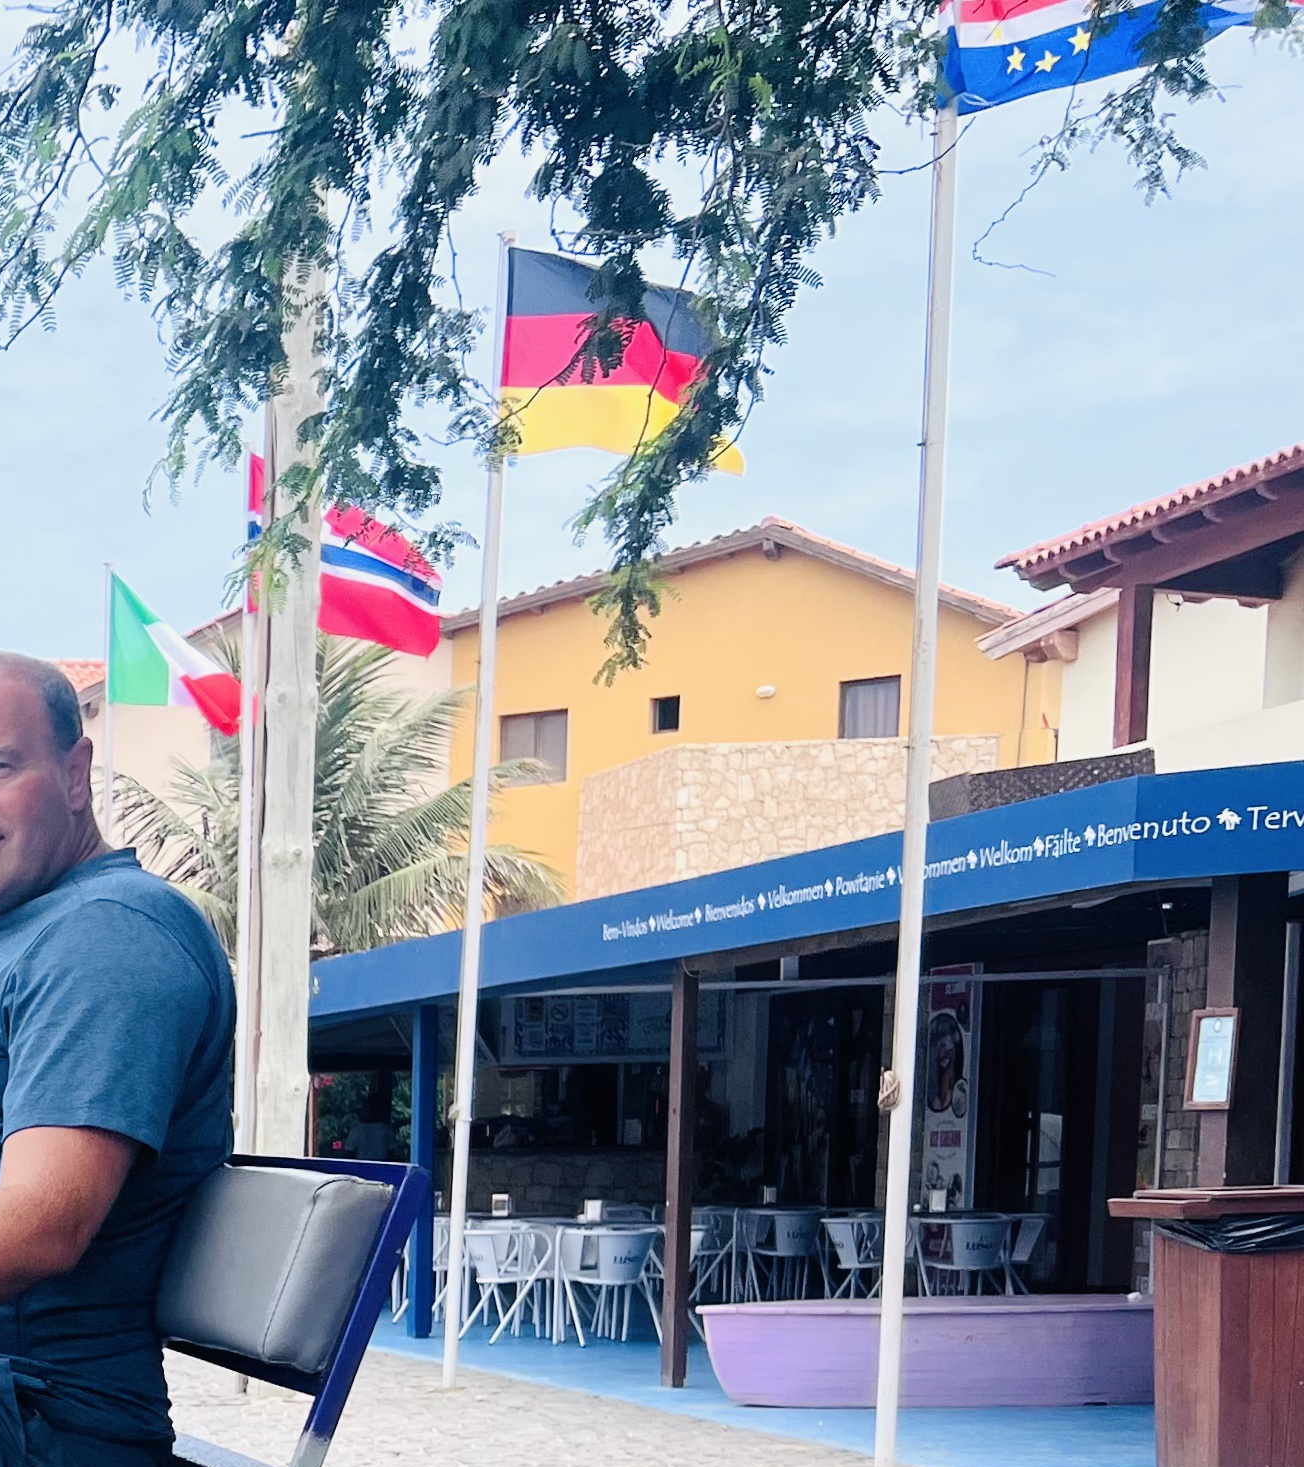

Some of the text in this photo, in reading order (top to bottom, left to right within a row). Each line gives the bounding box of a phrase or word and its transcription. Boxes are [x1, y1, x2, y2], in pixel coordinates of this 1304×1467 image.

[656, 908, 694, 932] Welcome
[767, 884, 823, 909] Velkommen
[980, 839, 1033, 868] Welkom
[1098, 810, 1210, 848] Benvenuto
